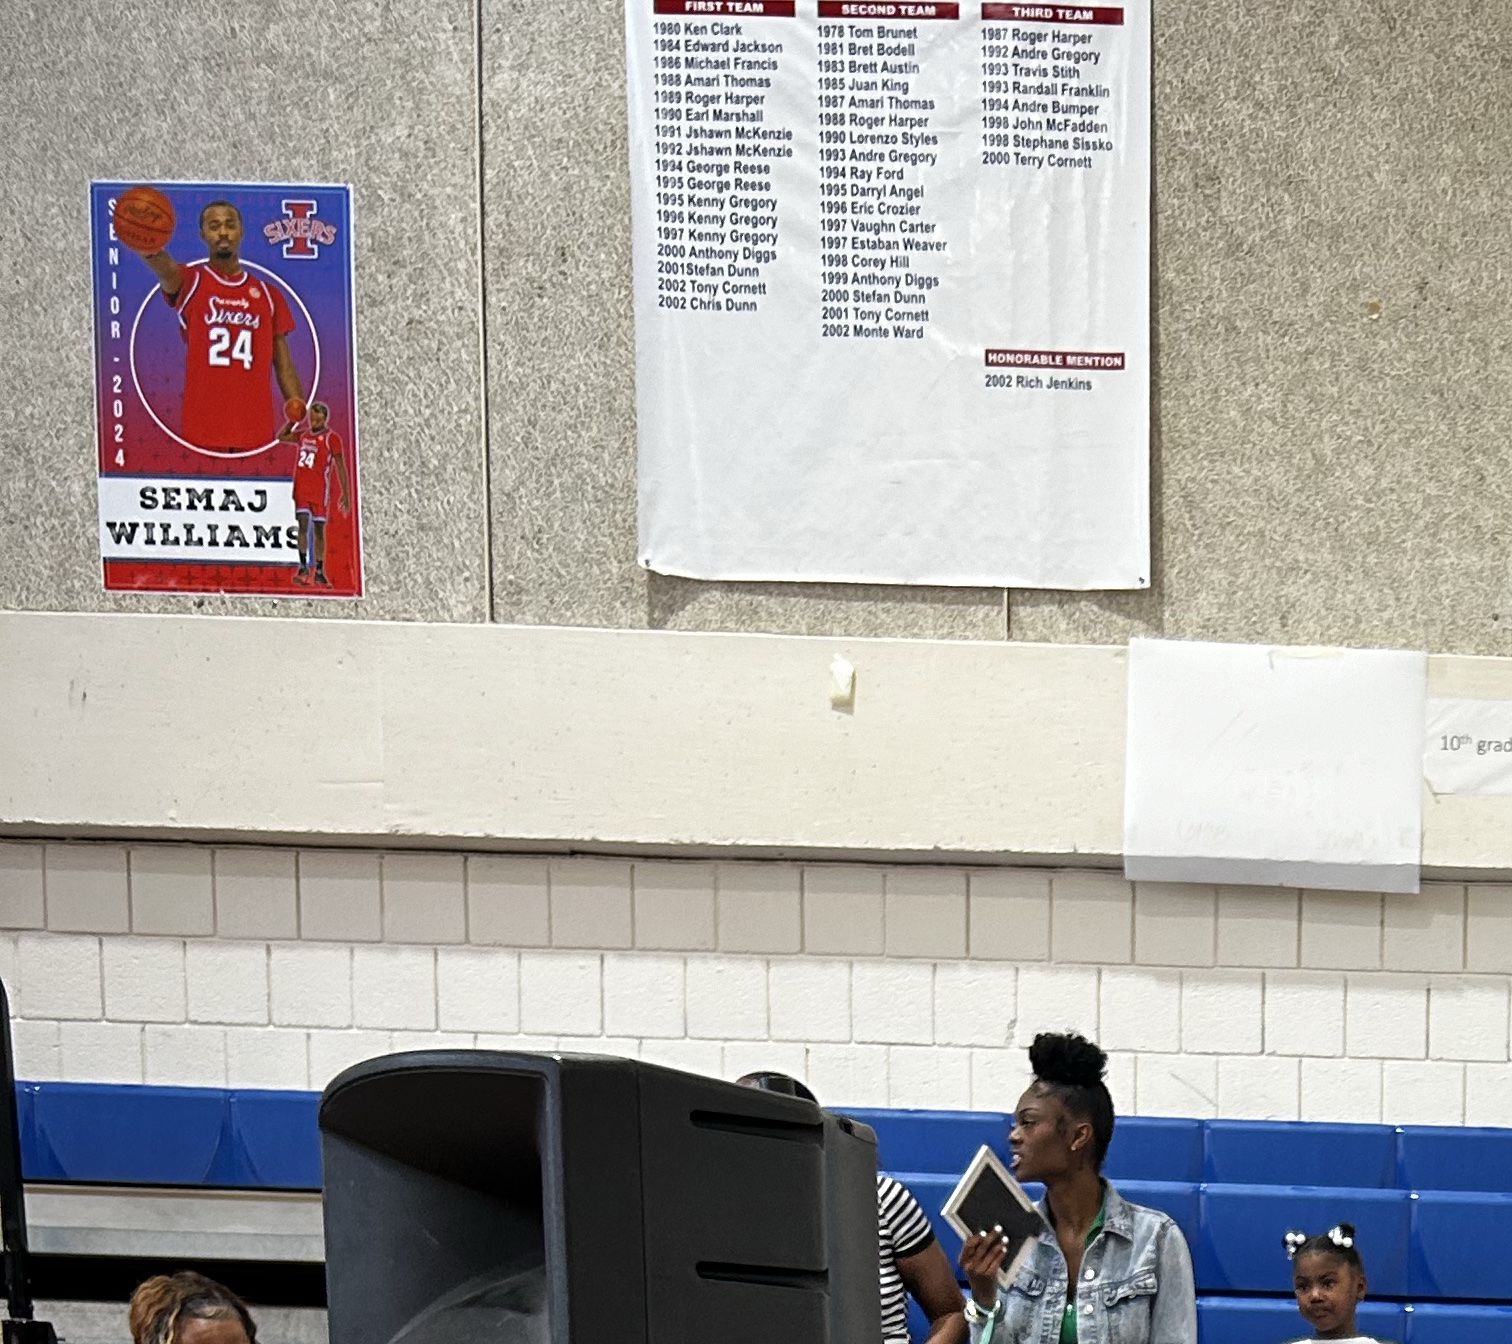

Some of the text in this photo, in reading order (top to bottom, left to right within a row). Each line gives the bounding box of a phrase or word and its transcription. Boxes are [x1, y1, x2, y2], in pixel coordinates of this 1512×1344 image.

[685, 1, 764, 13] FIRST TEAM
[841, 4, 936, 16] SECOND TEAM
[1012, 7, 1094, 21] THIRD TEAM
[653, 22, 743, 37] 1980 Ken Clark
[815, 24, 918, 40] 1978 Tom Brunet
[980, 26, 1094, 48] 1987 Roger Harper
[653, 38, 784, 54] 1984 Edward Jackson
[816, 42, 916, 57] 1981 Bret Bodell
[980, 44, 1101, 66] 1992 Andre Gregory
[652, 56, 779, 71] 1986 Michael Francis
[816, 59, 920, 75] 1983 Brett Austin
[981, 61, 1081, 80] 1993 Travis Stith
[817, 77, 910, 96] 1985 Juan King
[816, 94, 936, 110] 1987 Amari Thomas
[817, 112, 930, 132] 1988 Roger Harper
[981, 115, 1108, 134] 1998 John McFadden
[818, 130, 939, 150] 1990 Lorenzo Styles
[981, 132, 1010, 148] 1998
[1012, 134, 1070, 154] Stephane
[654, 158, 771, 177] 1994 George Reese
[818, 148, 938, 168] 1993 Andre Gregory
[981, 150, 1093, 171] 2000 Terry Cornett
[818, 165, 904, 184] 1994 Ray Ford
[655, 175, 772, 194] 1995 George Reese
[818, 182, 924, 202] 1995 Darryl Angel
[655, 192, 778, 212] 1995 Kenny Gregory
[819, 200, 922, 216] 1996 Eric Crozier
[656, 209, 778, 229] 1996 Kenny Gregory
[820, 218, 937, 237] 1997 Vaughn Carter
[263, 217, 338, 245] SIXERS
[656, 226, 779, 246] 1997 Kenny Gregory
[820, 235, 948, 252] 1997 Estaban Weaver
[656, 243, 777, 264] 2000 Anthony Diggs
[820, 253, 910, 272] 1998 Corey Hill
[727, 262, 760, 277] Dunn
[657, 277, 767, 297] 2002 Tony Cornett
[820, 271, 940, 291] 1999 Anthony Diggs
[658, 295, 758, 311] 2002 Chris Dunn
[821, 288, 926, 304] 2000 Stefan Dunn
[821, 306, 930, 325] 2001 Tony Cornett
[821, 323, 924, 339] 2002 Monte Ward
[208, 327, 255, 370] 24
[987, 352, 1123, 368] HONORABLE MENTION
[984, 374, 1092, 391] 2002 Rich Jenkins
[139, 486, 268, 513] SEMAJ
[106, 521, 299, 551] WILLIAMS
